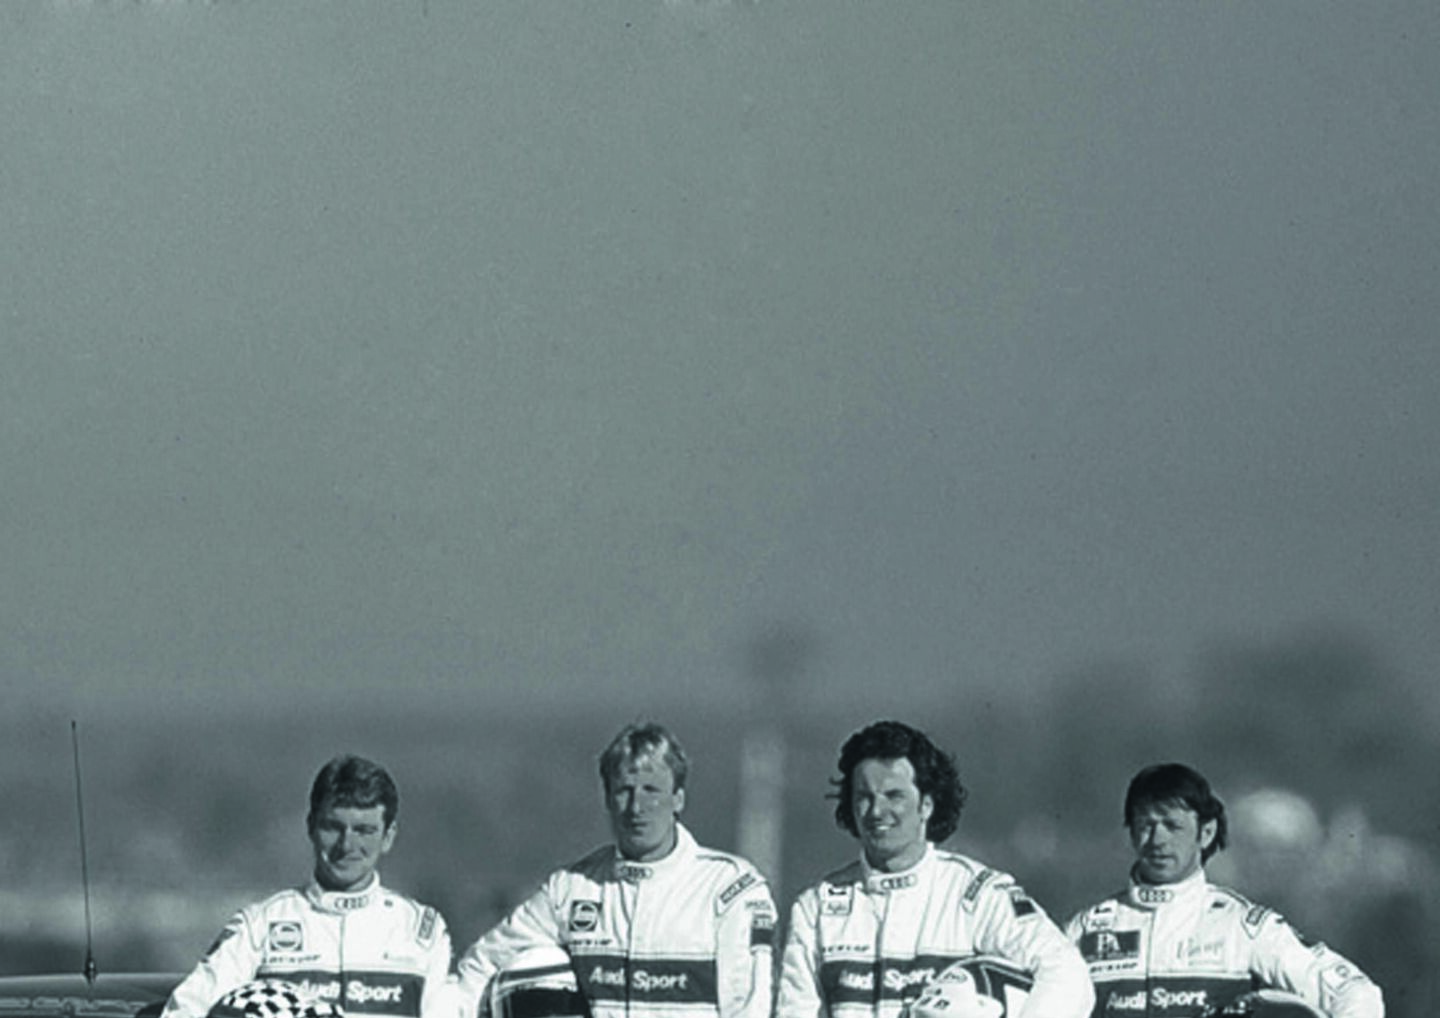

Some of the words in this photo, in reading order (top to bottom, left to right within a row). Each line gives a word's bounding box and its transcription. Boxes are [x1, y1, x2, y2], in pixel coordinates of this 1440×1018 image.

[299, 980, 341, 999] Audi
[345, 979, 403, 1003] Sport
[632, 970, 688, 993] Sport
[839, 970, 875, 990] Audi
[882, 967, 937, 992] Sport
[1106, 991, 1148, 1010] Audi
[1150, 986, 1208, 1009] Sport
